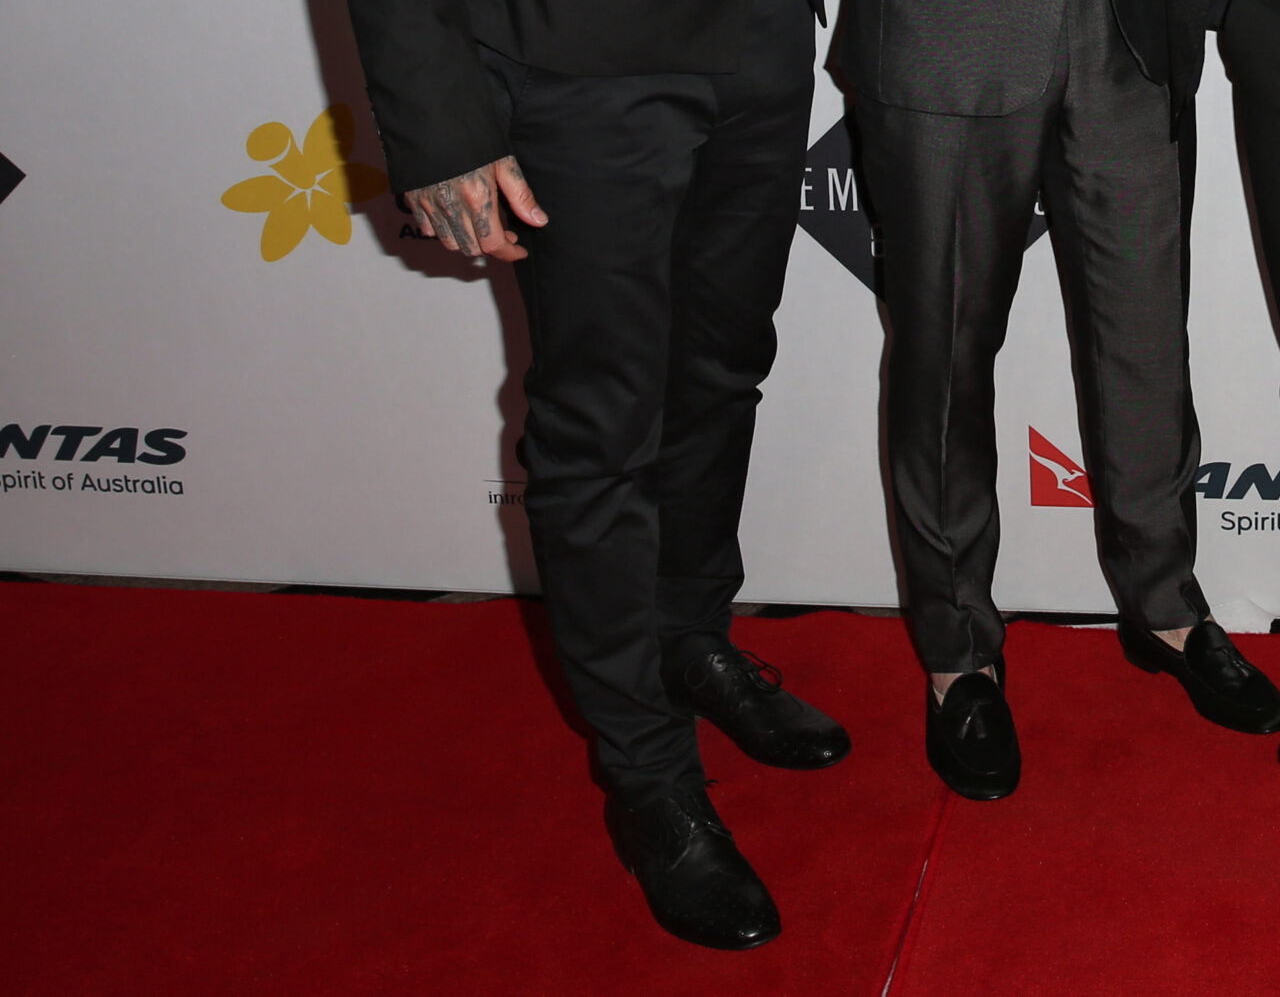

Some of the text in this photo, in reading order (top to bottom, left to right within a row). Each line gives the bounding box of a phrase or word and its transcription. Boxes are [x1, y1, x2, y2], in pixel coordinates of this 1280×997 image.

[0, 470, 184, 495] pirit of Australia
